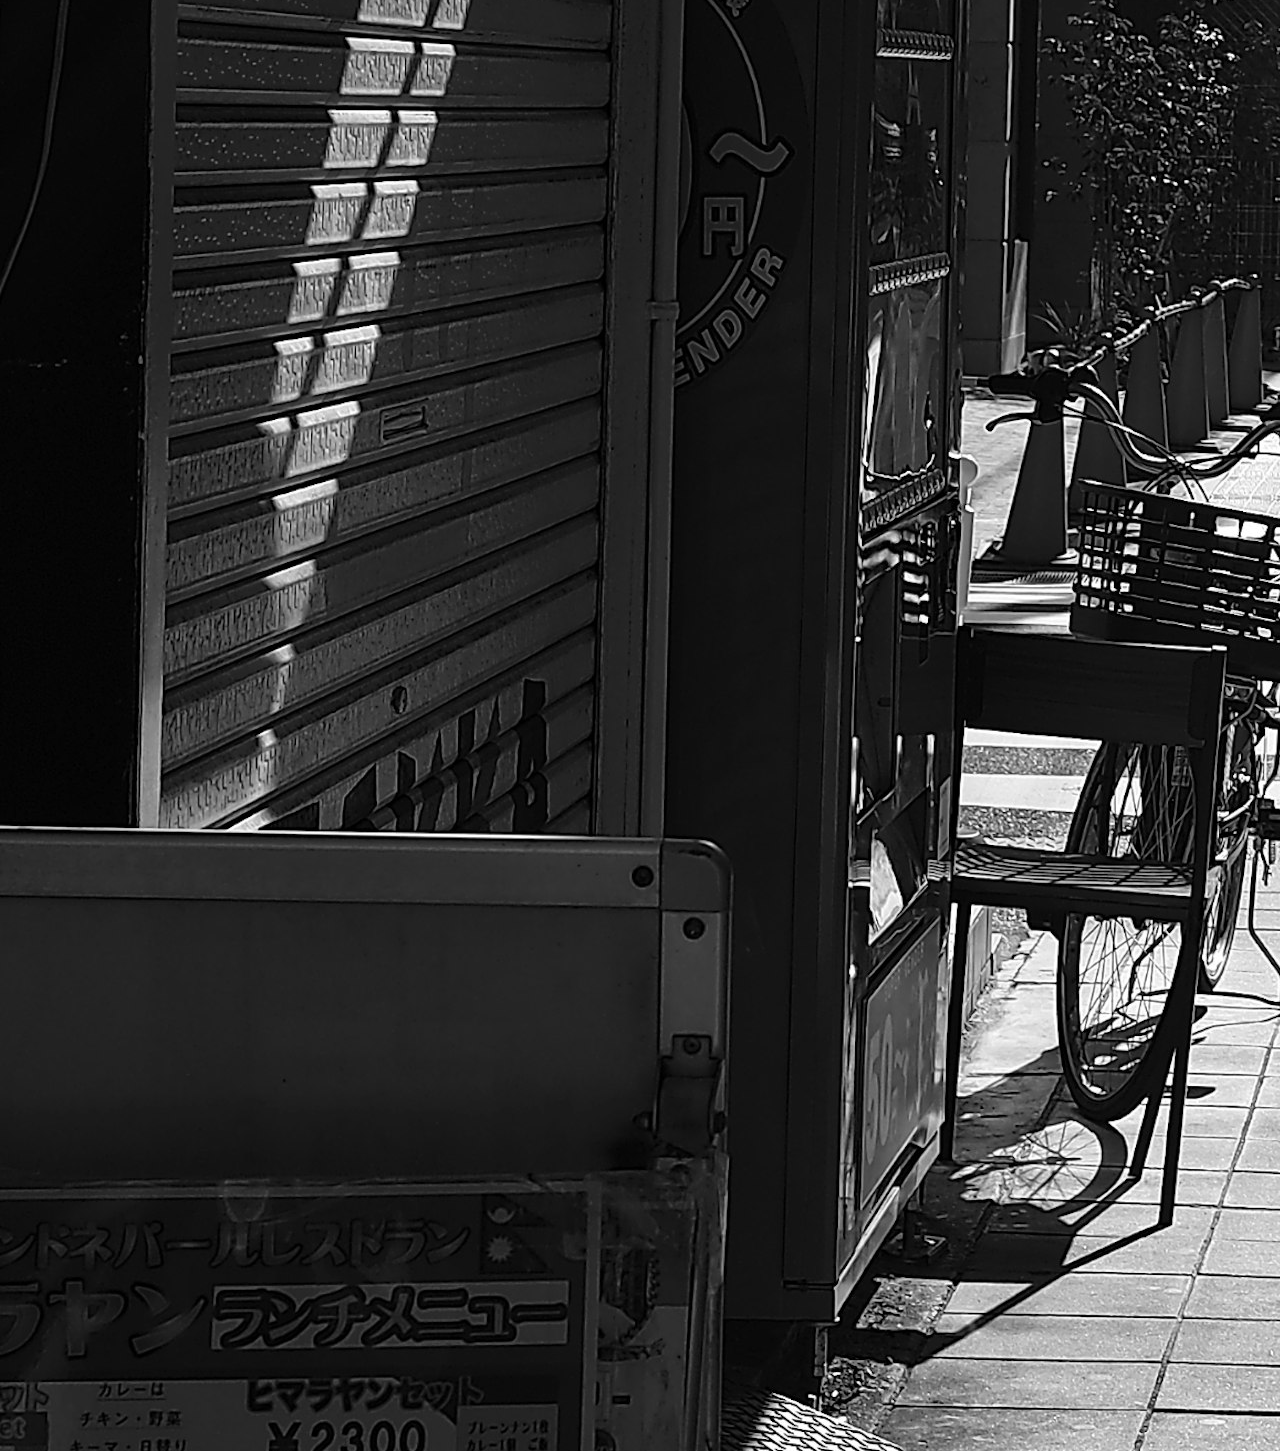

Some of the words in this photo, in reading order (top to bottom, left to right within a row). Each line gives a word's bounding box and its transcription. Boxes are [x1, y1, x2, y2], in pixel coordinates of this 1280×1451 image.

[215, 1284, 567, 1347] ランチメニュー
[99, 1382, 165, 1398] カレーは
[247, 1375, 485, 1413] ヒマラヤンセット
[80, 1410, 182, 1427] チキン・野菜
